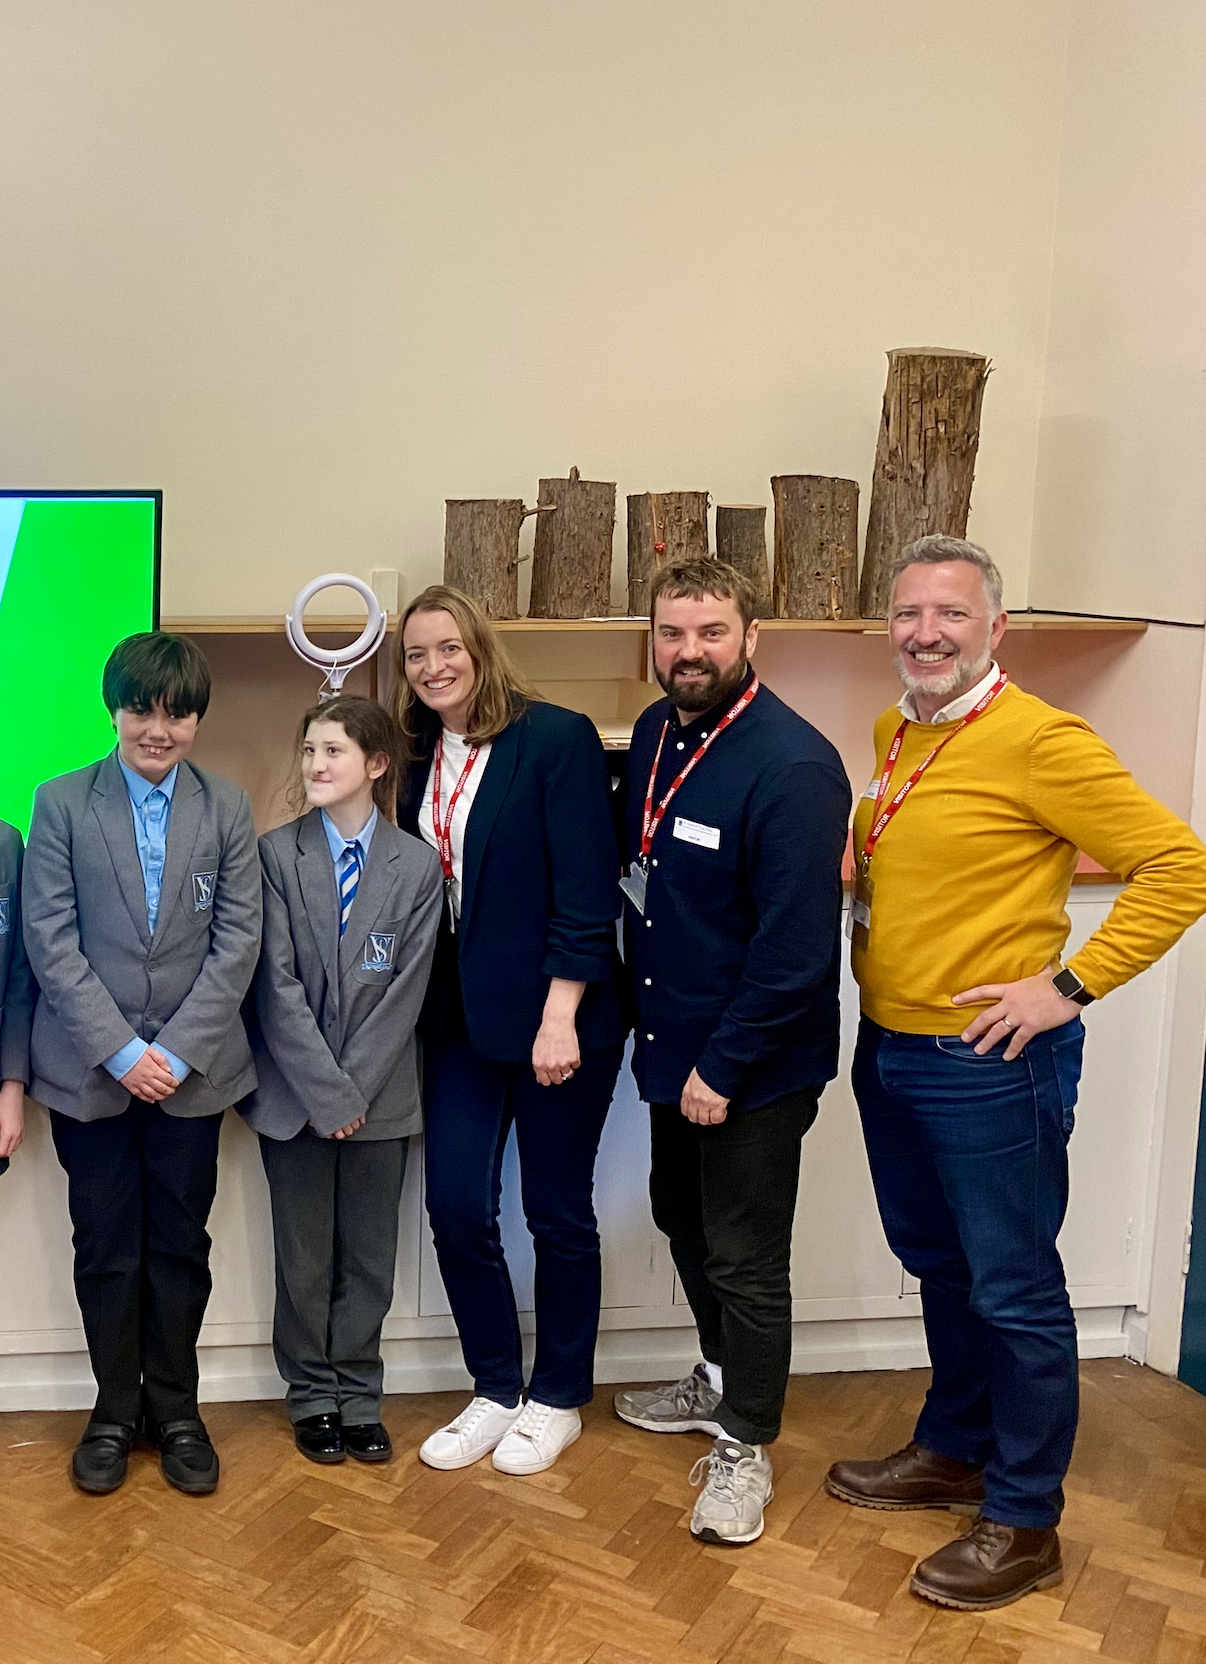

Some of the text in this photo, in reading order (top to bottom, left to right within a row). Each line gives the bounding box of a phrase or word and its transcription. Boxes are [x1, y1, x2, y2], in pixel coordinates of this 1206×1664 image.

[727, 699, 747, 719] VISITOR
[975, 690, 995, 711] VISITOR
[889, 737, 901, 761] VISITOR
[680, 757, 697, 779] VISITOR
[456, 771, 468, 793] VISITOR
[879, 771, 890, 795] VISITOR
[893, 781, 912, 804] VISITOR
[446, 804, 455, 827] VISITOR
[872, 813, 890, 837] VISITOR
[647, 818, 659, 838] VISITOR
